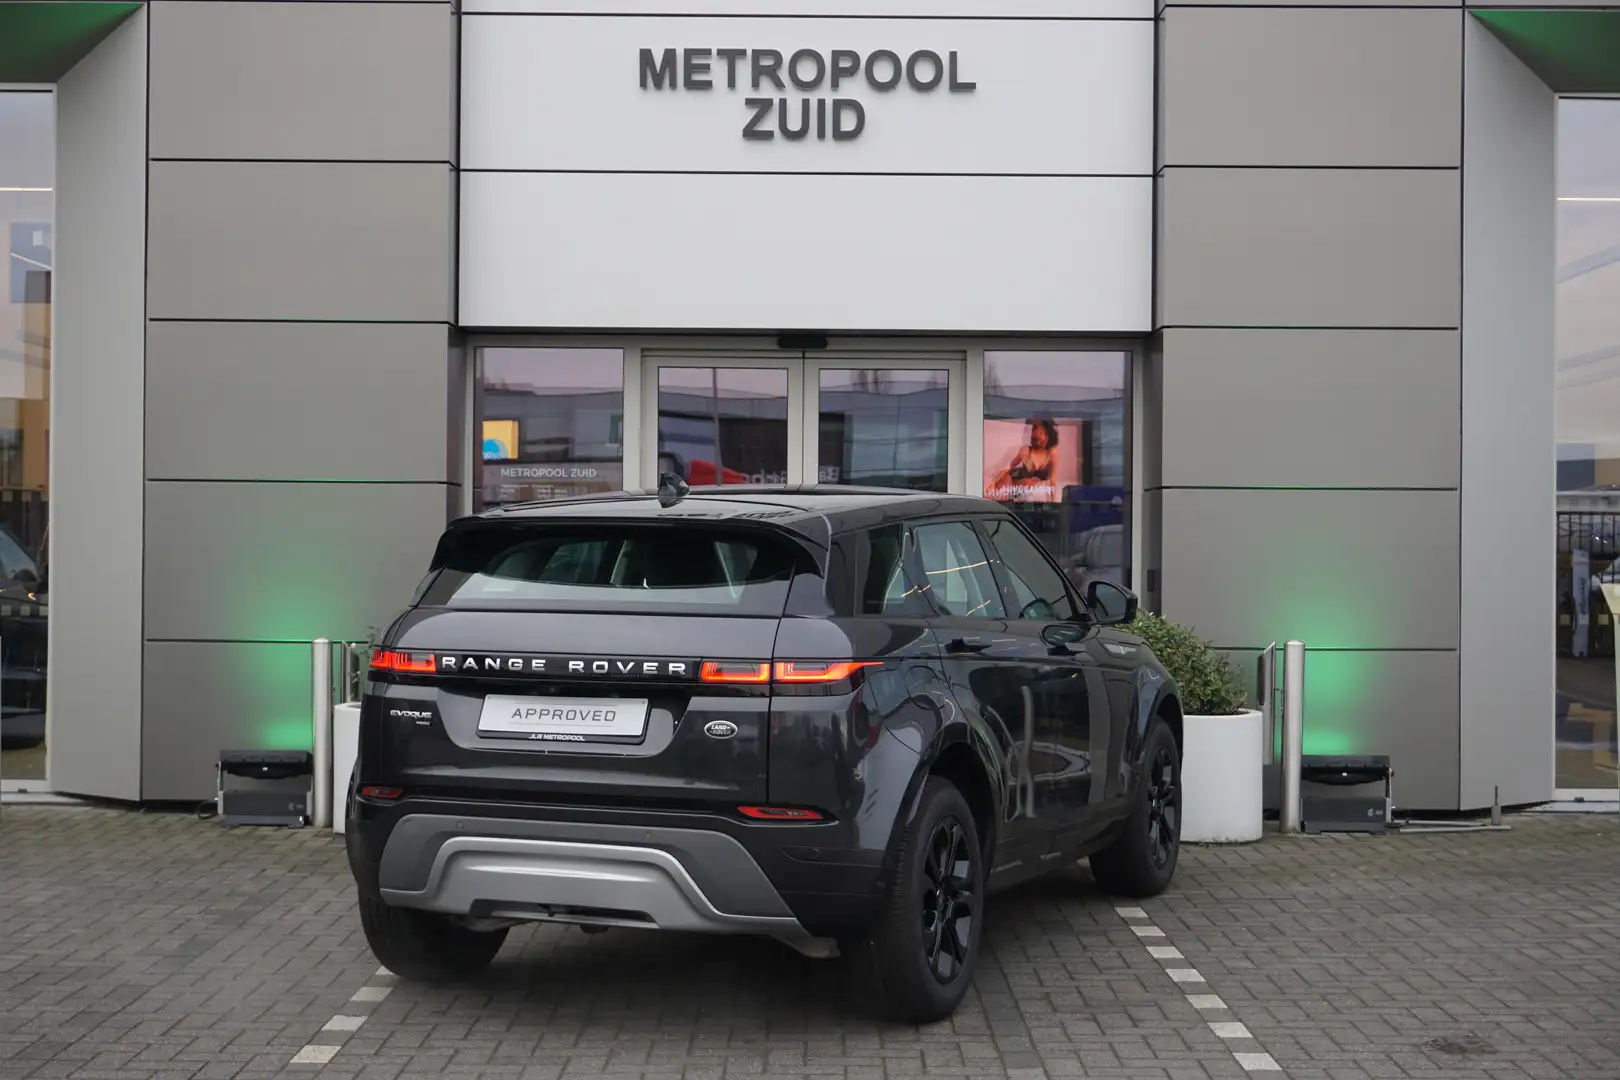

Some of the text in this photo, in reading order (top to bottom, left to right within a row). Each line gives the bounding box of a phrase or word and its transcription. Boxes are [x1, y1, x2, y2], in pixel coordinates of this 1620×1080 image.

[639, 48, 977, 91] METROPOOL
[742, 97, 866, 140] ZUID
[500, 468, 597, 478] METROPOOL ZUID
[441, 656, 687, 675] RANGE ROVER
[390, 709, 432, 719] EVOQUE
[510, 707, 617, 722] APPROVED
